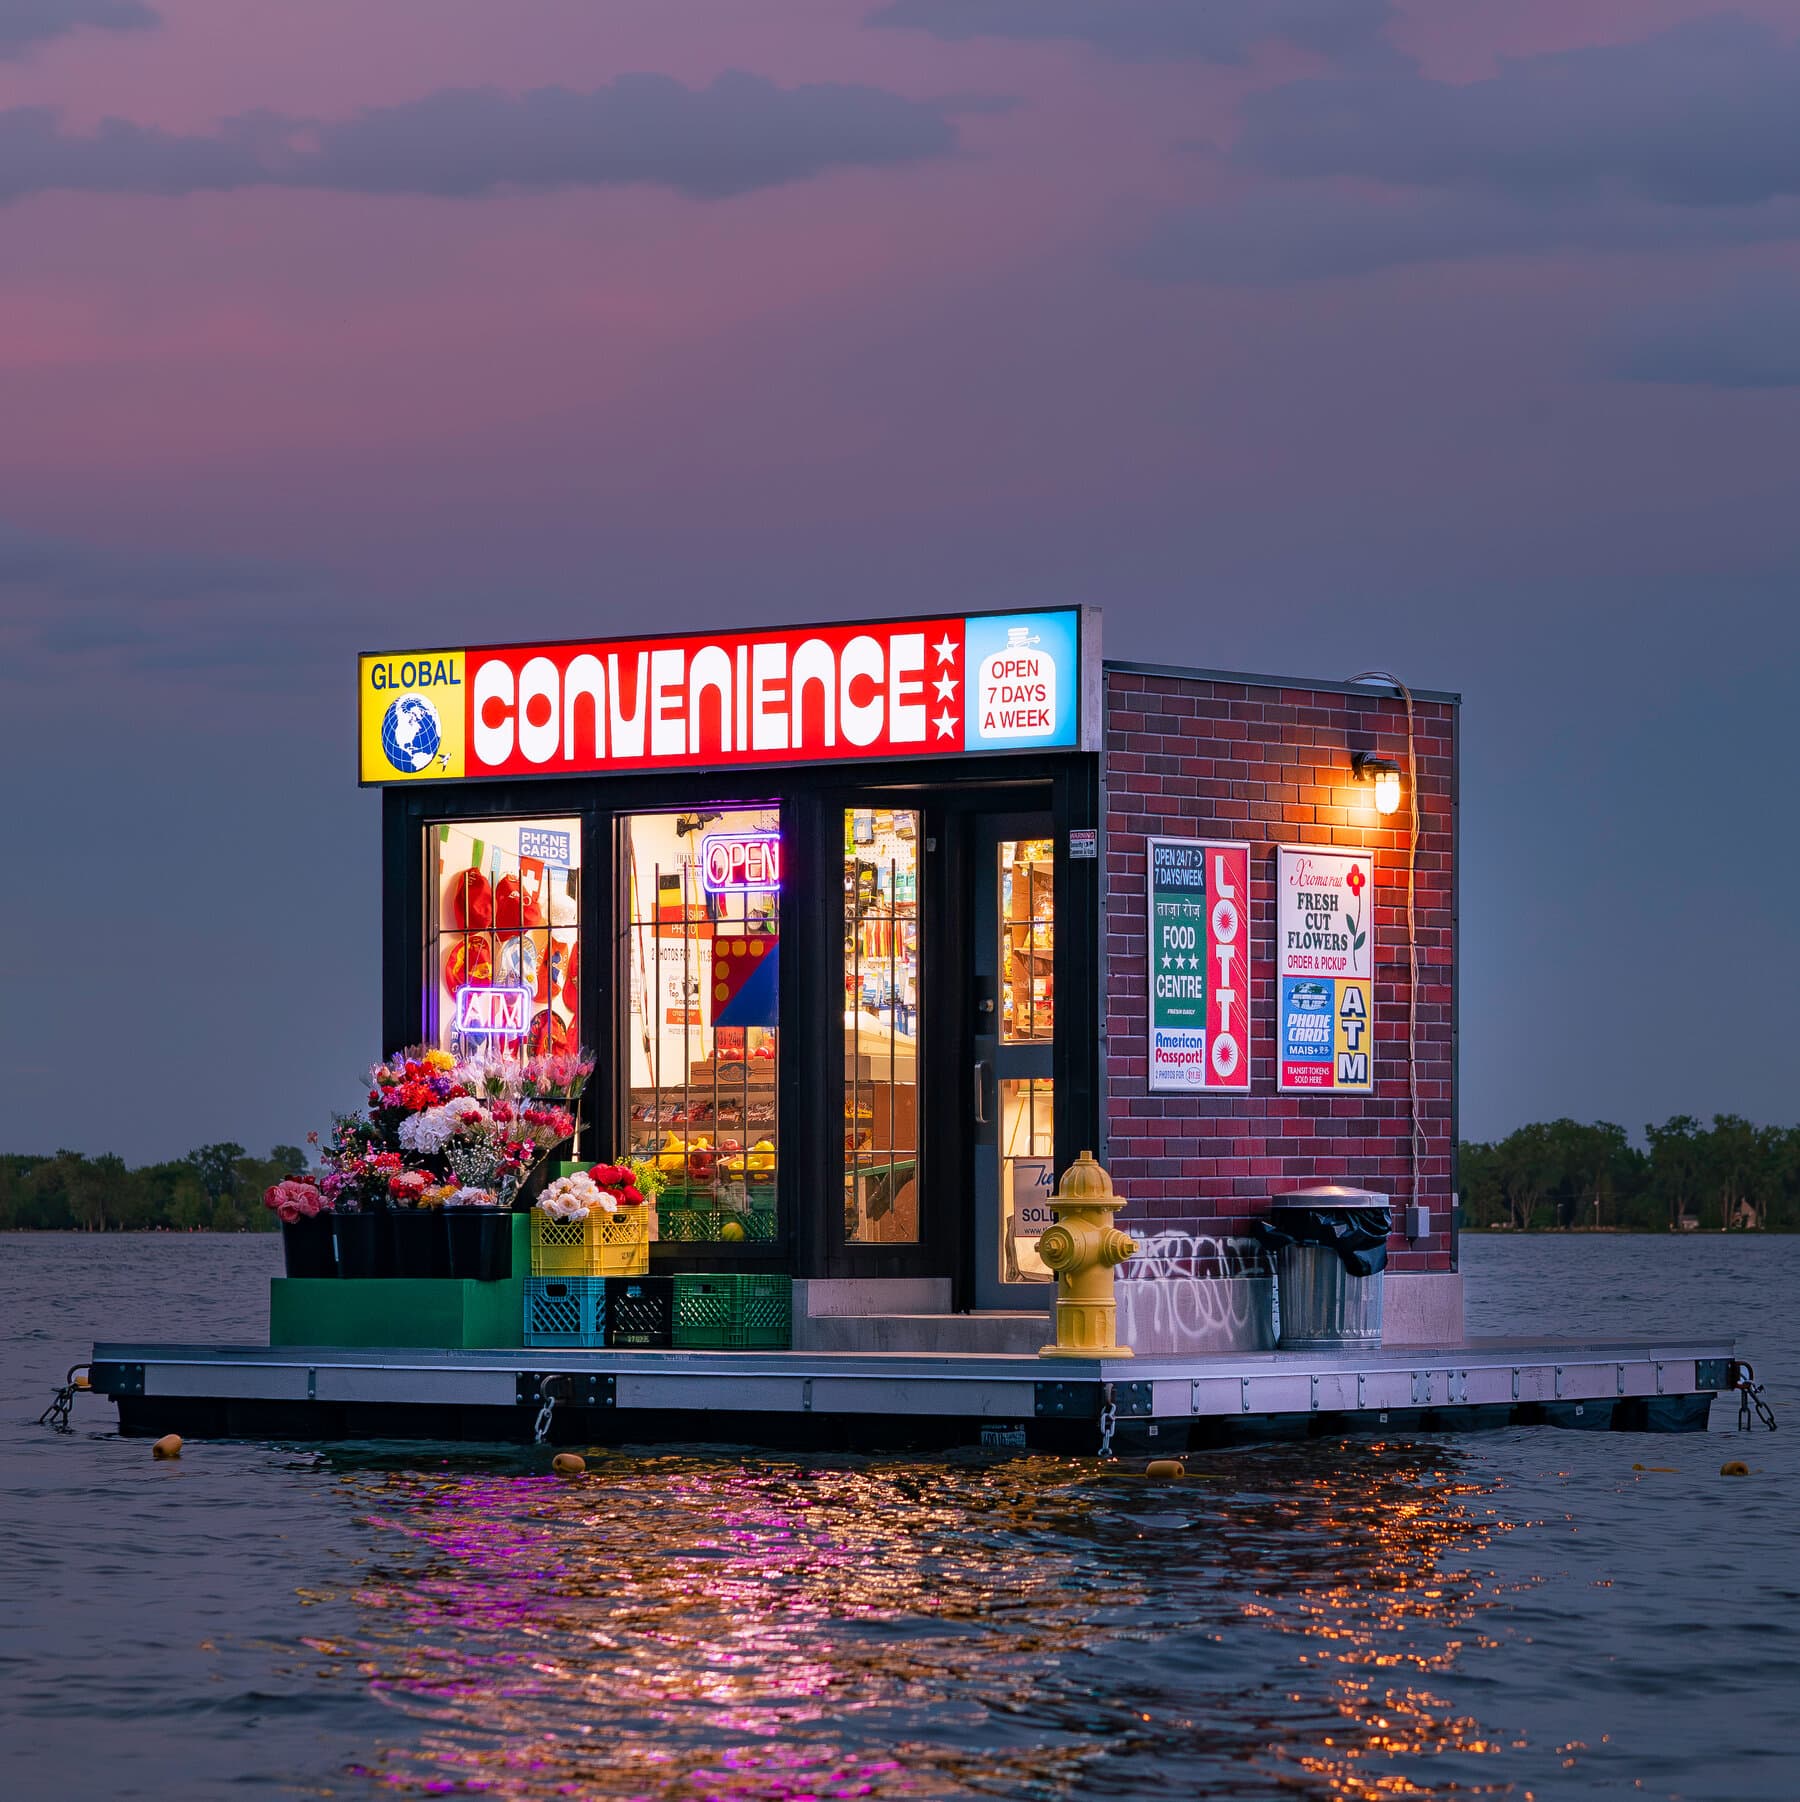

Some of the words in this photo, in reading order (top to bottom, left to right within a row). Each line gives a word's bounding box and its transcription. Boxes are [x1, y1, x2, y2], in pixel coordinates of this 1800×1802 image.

[371, 659, 461, 690] GLOBAL
[991, 659, 1039, 679] OPEN
[474, 633, 927, 766] CONVENIENCE
[988, 687, 997, 704] 7
[1001, 684, 1046, 703] DAYS
[984, 711, 996, 729] A
[1000, 708, 1050, 728] WEEK
[522, 831, 567, 848] PHONE
[521, 844, 568, 860] CARDS
[1155, 848, 1175, 866] OPEN
[1176, 849, 1192, 867] 24/7
[708, 842, 779, 884] OPEN
[1155, 868, 1160, 884] 7
[1297, 892, 1339, 911] FRESH
[1305, 913, 1331, 930] CUT
[1163, 926, 1195, 949] FOOD
[1287, 931, 1348, 951] FLOWERS
[1212, 855, 1238, 1077] LOTTO
[1287, 955, 1313, 969] ORDER
[1314, 957, 1320, 969] &
[1321, 957, 1347, 970] PICKUP
[1156, 974, 1202, 998] CENTRE
[463, 990, 522, 1028] ATM
[1287, 1013, 1332, 1028] PHONE
[1156, 1032, 1202, 1048] American
[1288, 1028, 1331, 1042] CARDS
[1338, 986, 1368, 1084] ATM
[1294, 1076, 1309, 1084] SOLD
[1309, 1076, 1322, 1084] HERE
